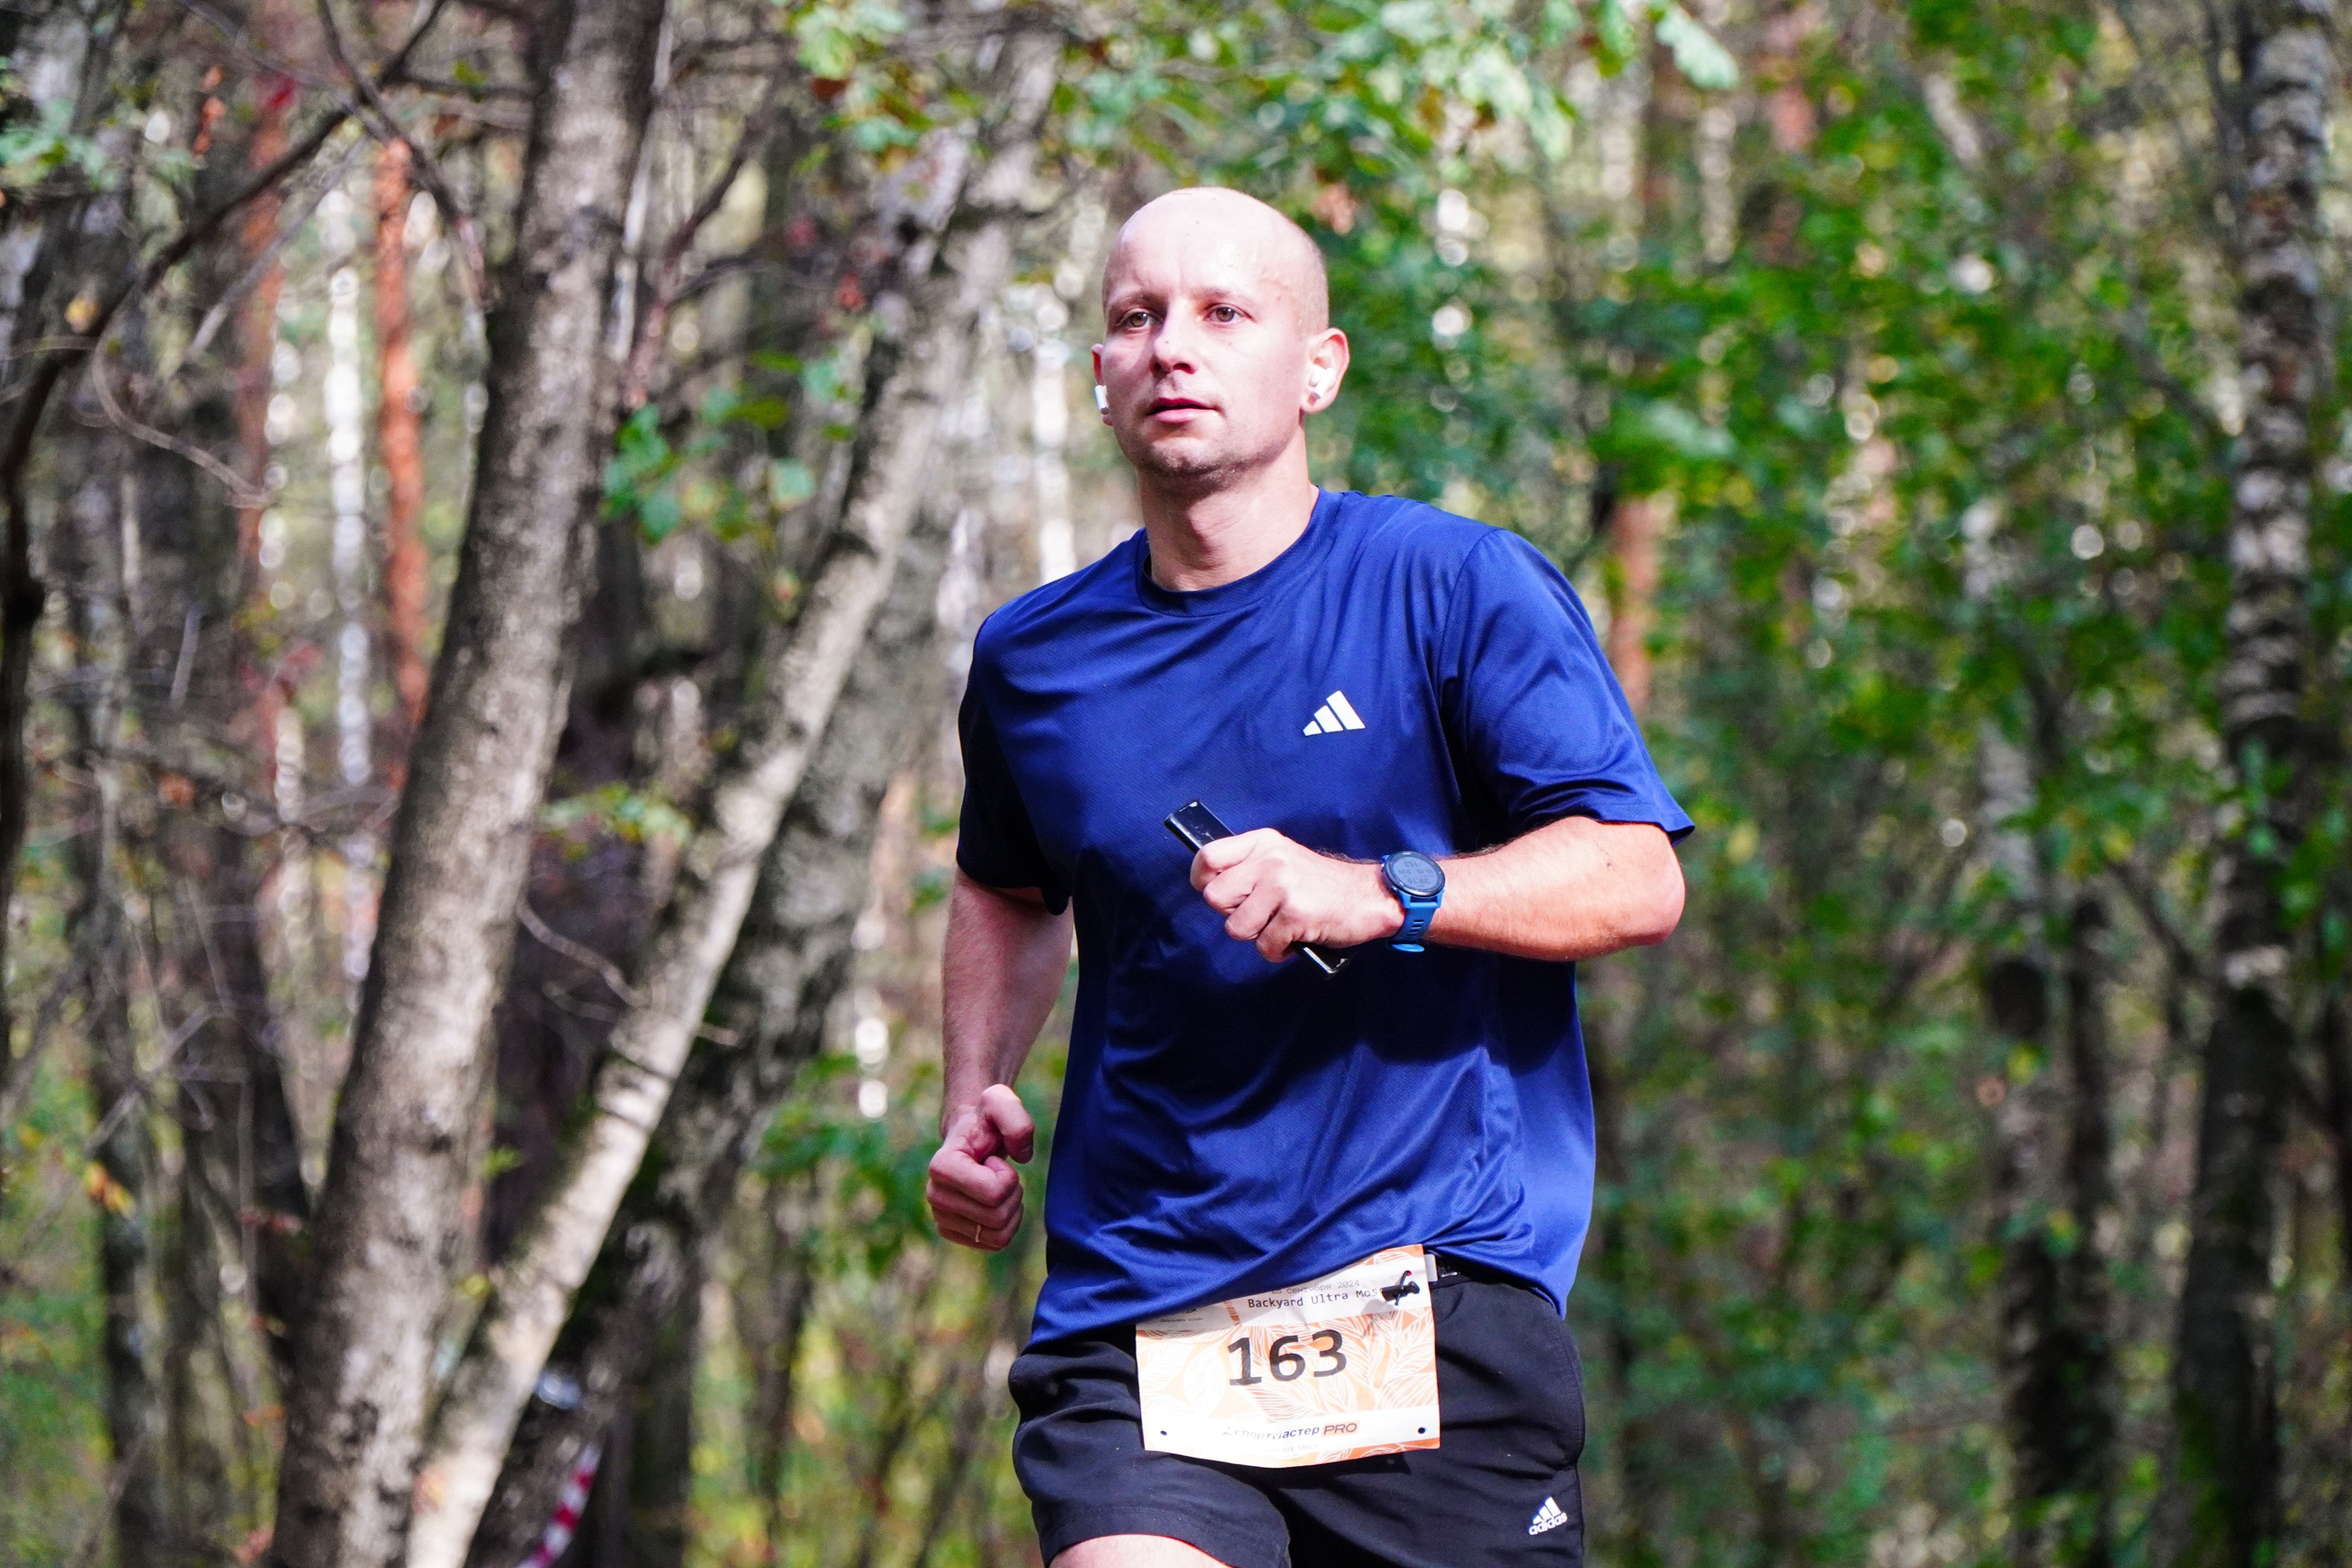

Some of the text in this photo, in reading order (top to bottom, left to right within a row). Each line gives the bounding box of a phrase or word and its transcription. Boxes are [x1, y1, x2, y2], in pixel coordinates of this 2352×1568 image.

[1337, 1280, 1360, 1289] 2024
[1248, 1297, 1304, 1310] Backyard
[1310, 1292, 1349, 1304] Ultra
[1227, 1328, 1348, 1386] 163
[1323, 1422, 1358, 1436] PRO
[1529, 1512, 1568, 1536] adidas
